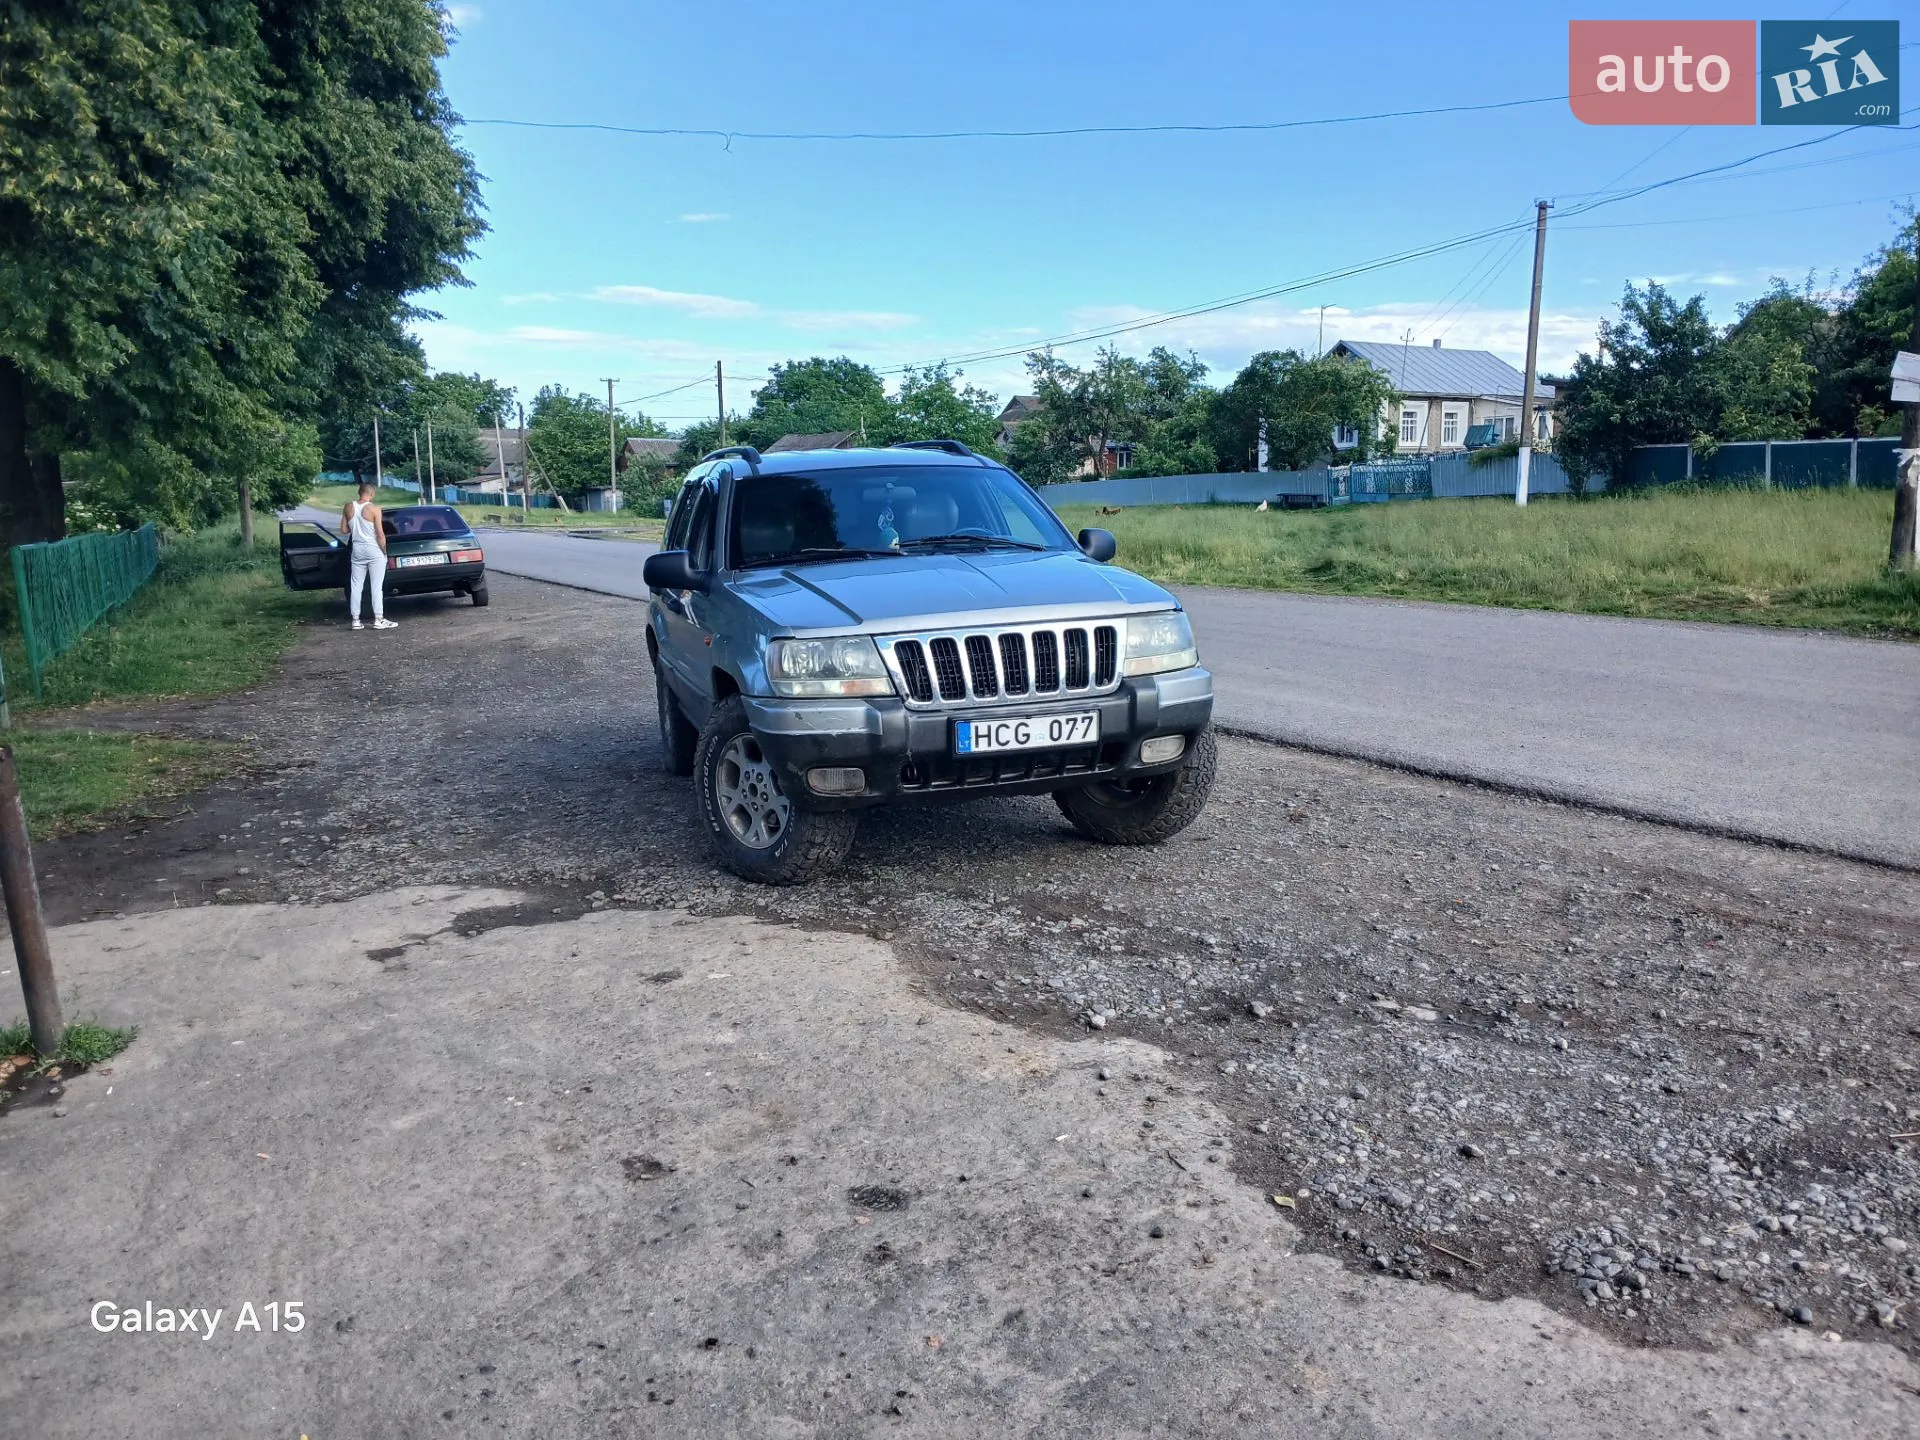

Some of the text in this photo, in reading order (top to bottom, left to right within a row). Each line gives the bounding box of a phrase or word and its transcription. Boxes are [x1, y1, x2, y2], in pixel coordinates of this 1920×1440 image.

[974, 715, 1094, 748] HCG 077
[958, 739, 970, 749] LT
